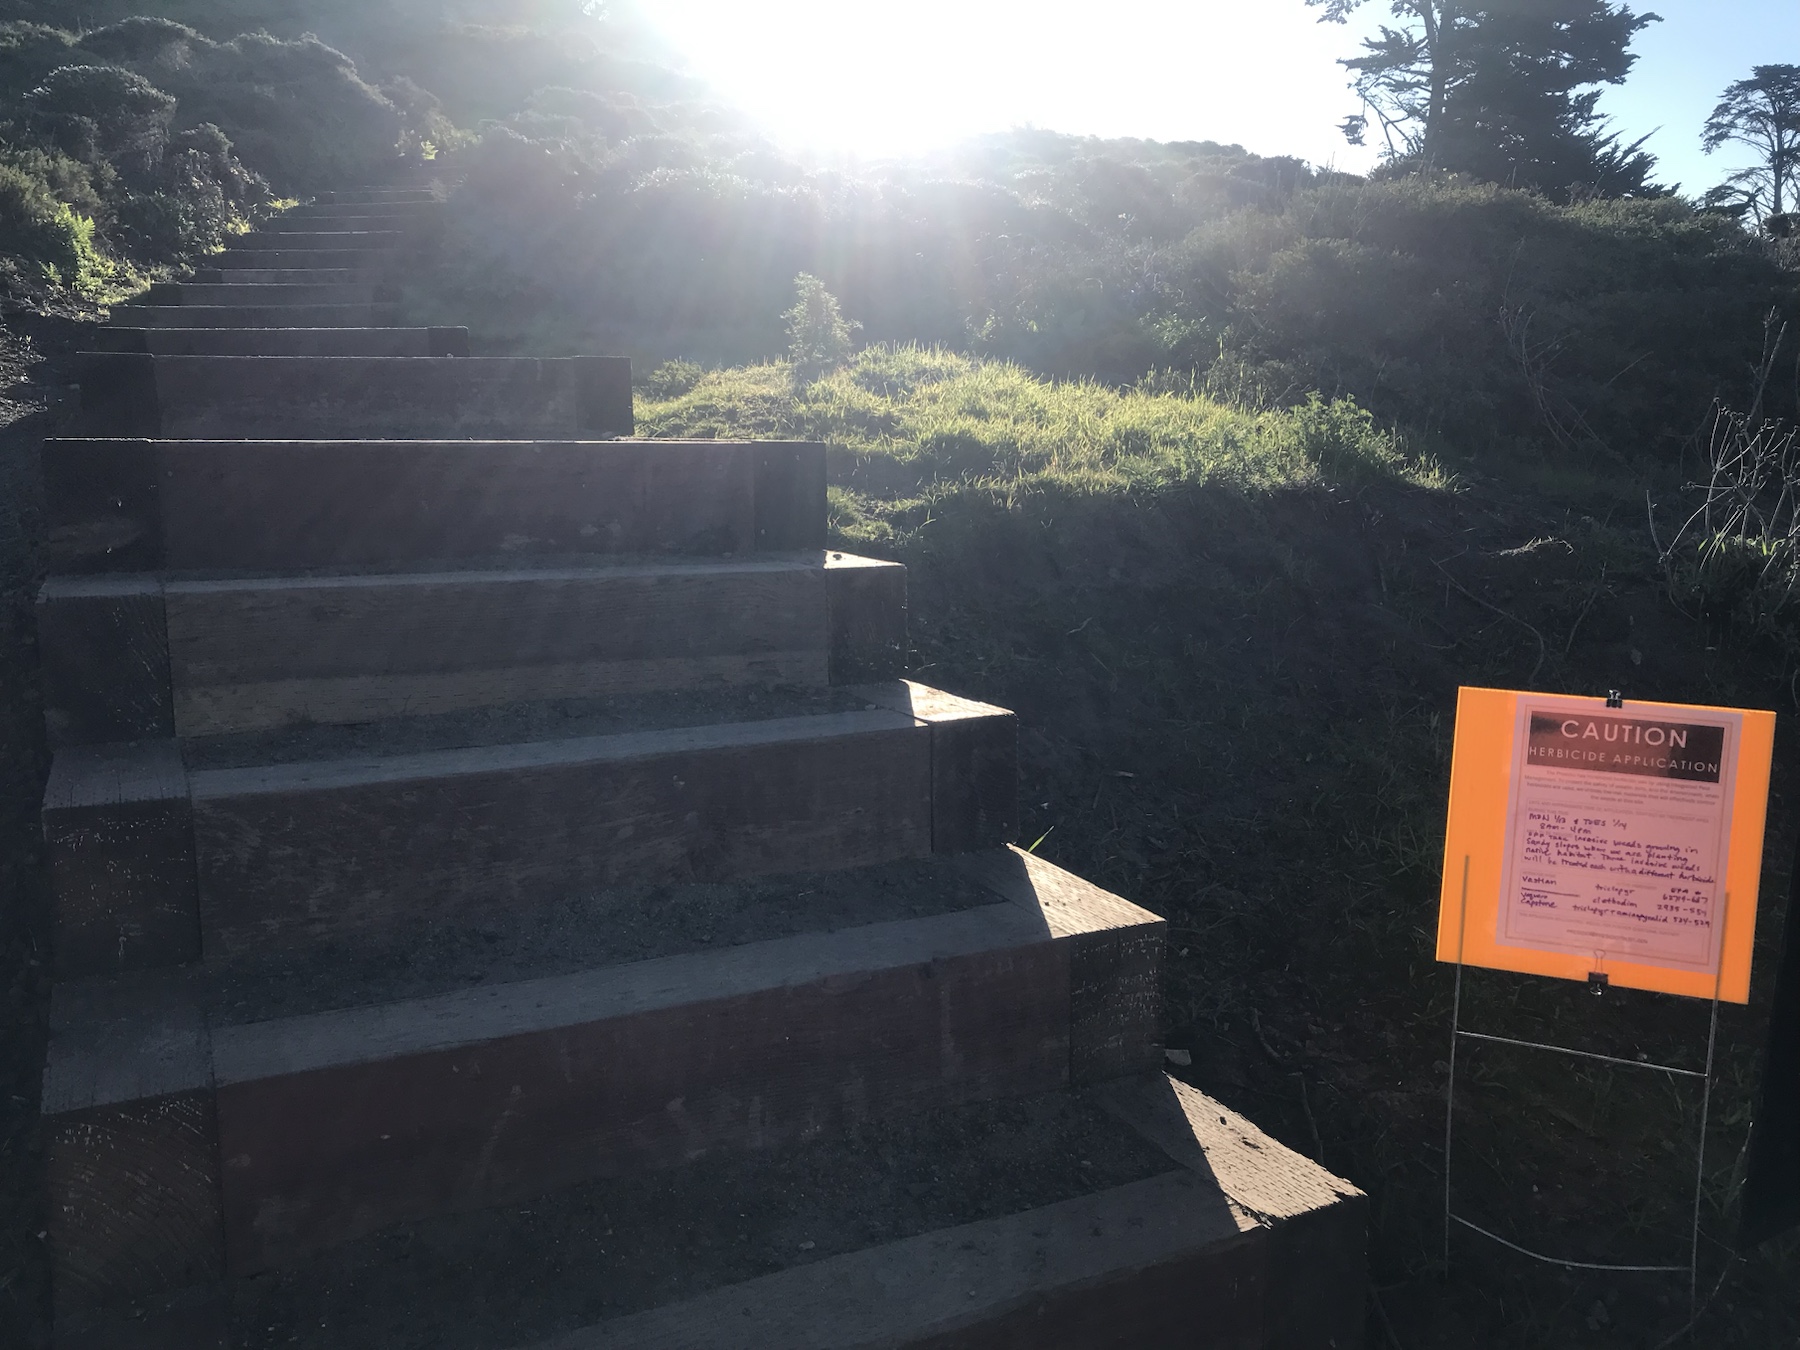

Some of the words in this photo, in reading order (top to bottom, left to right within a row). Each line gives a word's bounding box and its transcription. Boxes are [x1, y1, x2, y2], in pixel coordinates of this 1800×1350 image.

[1561, 719, 1688, 749] CAUTION
[1529, 745, 1606, 763] HERBICIDE
[1612, 754, 1718, 774] APPLICATION
[1524, 855, 1542, 863] will
